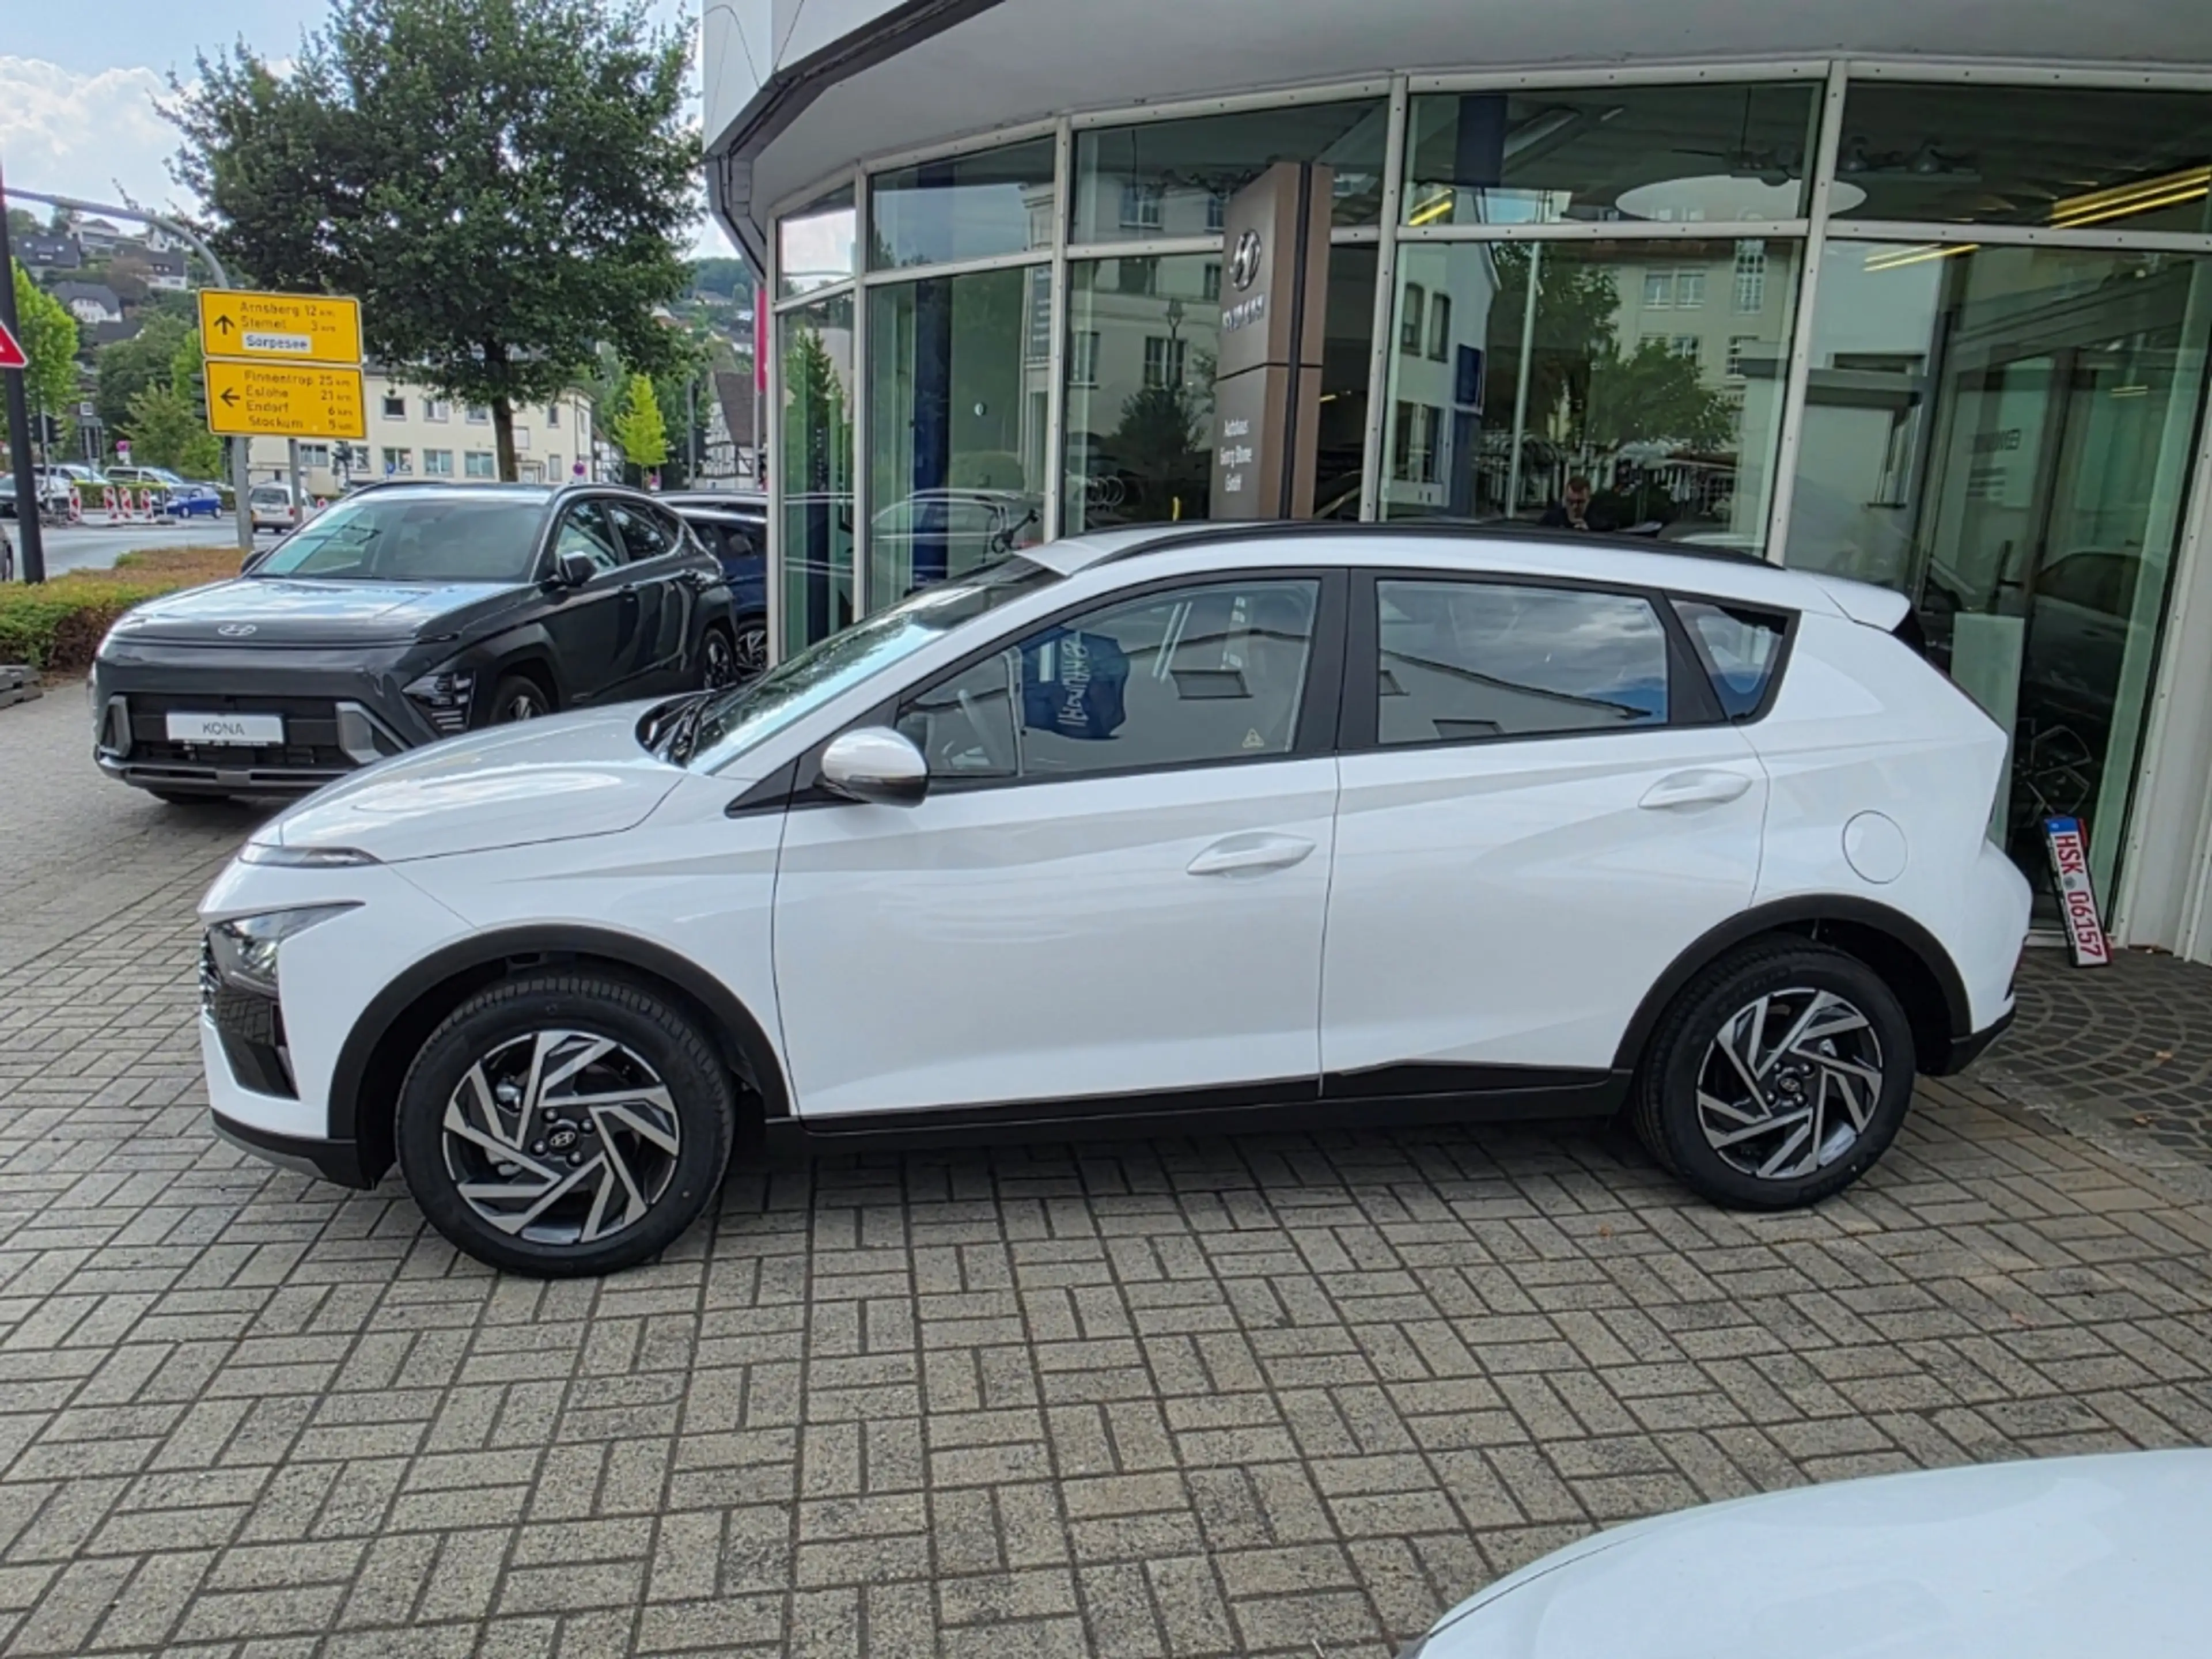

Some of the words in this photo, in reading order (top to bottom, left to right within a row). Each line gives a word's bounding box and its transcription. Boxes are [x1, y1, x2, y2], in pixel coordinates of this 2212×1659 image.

[240, 301, 299, 317] Arnsberg
[304, 304, 316, 316] 12
[240, 315, 286, 329] Stemel
[246, 334, 308, 350] Sorpesee
[246, 384, 289, 397] Eslohe
[320, 389, 334, 401] 21
[328, 404, 335, 416] 6
[248, 415, 304, 429] Stockum
[203, 722, 245, 736] KONA
[2054, 835, 2084, 874] HSK
[2067, 891, 2102, 957] 06157
